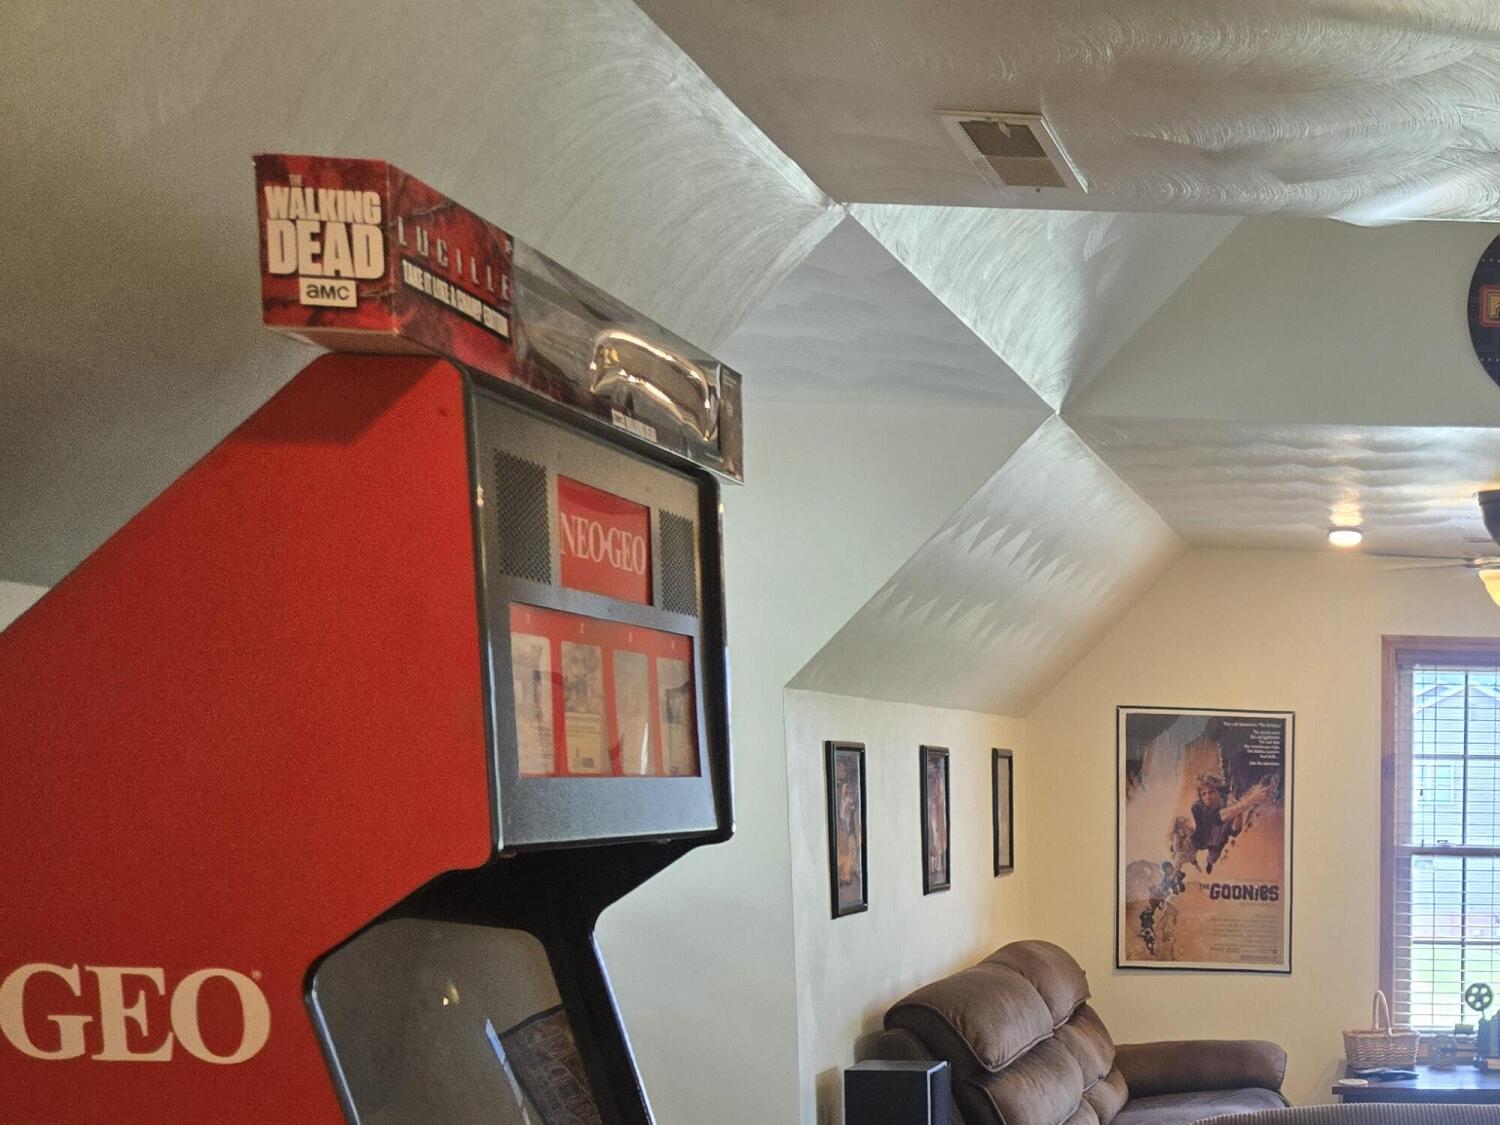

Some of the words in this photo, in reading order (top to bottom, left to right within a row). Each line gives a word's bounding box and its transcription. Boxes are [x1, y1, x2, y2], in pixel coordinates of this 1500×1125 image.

[264, 186, 382, 225] WALKING
[267, 218, 385, 280] DEAD
[398, 215, 511, 301] LUCILLE
[0, 963, 271, 1064] GEO
